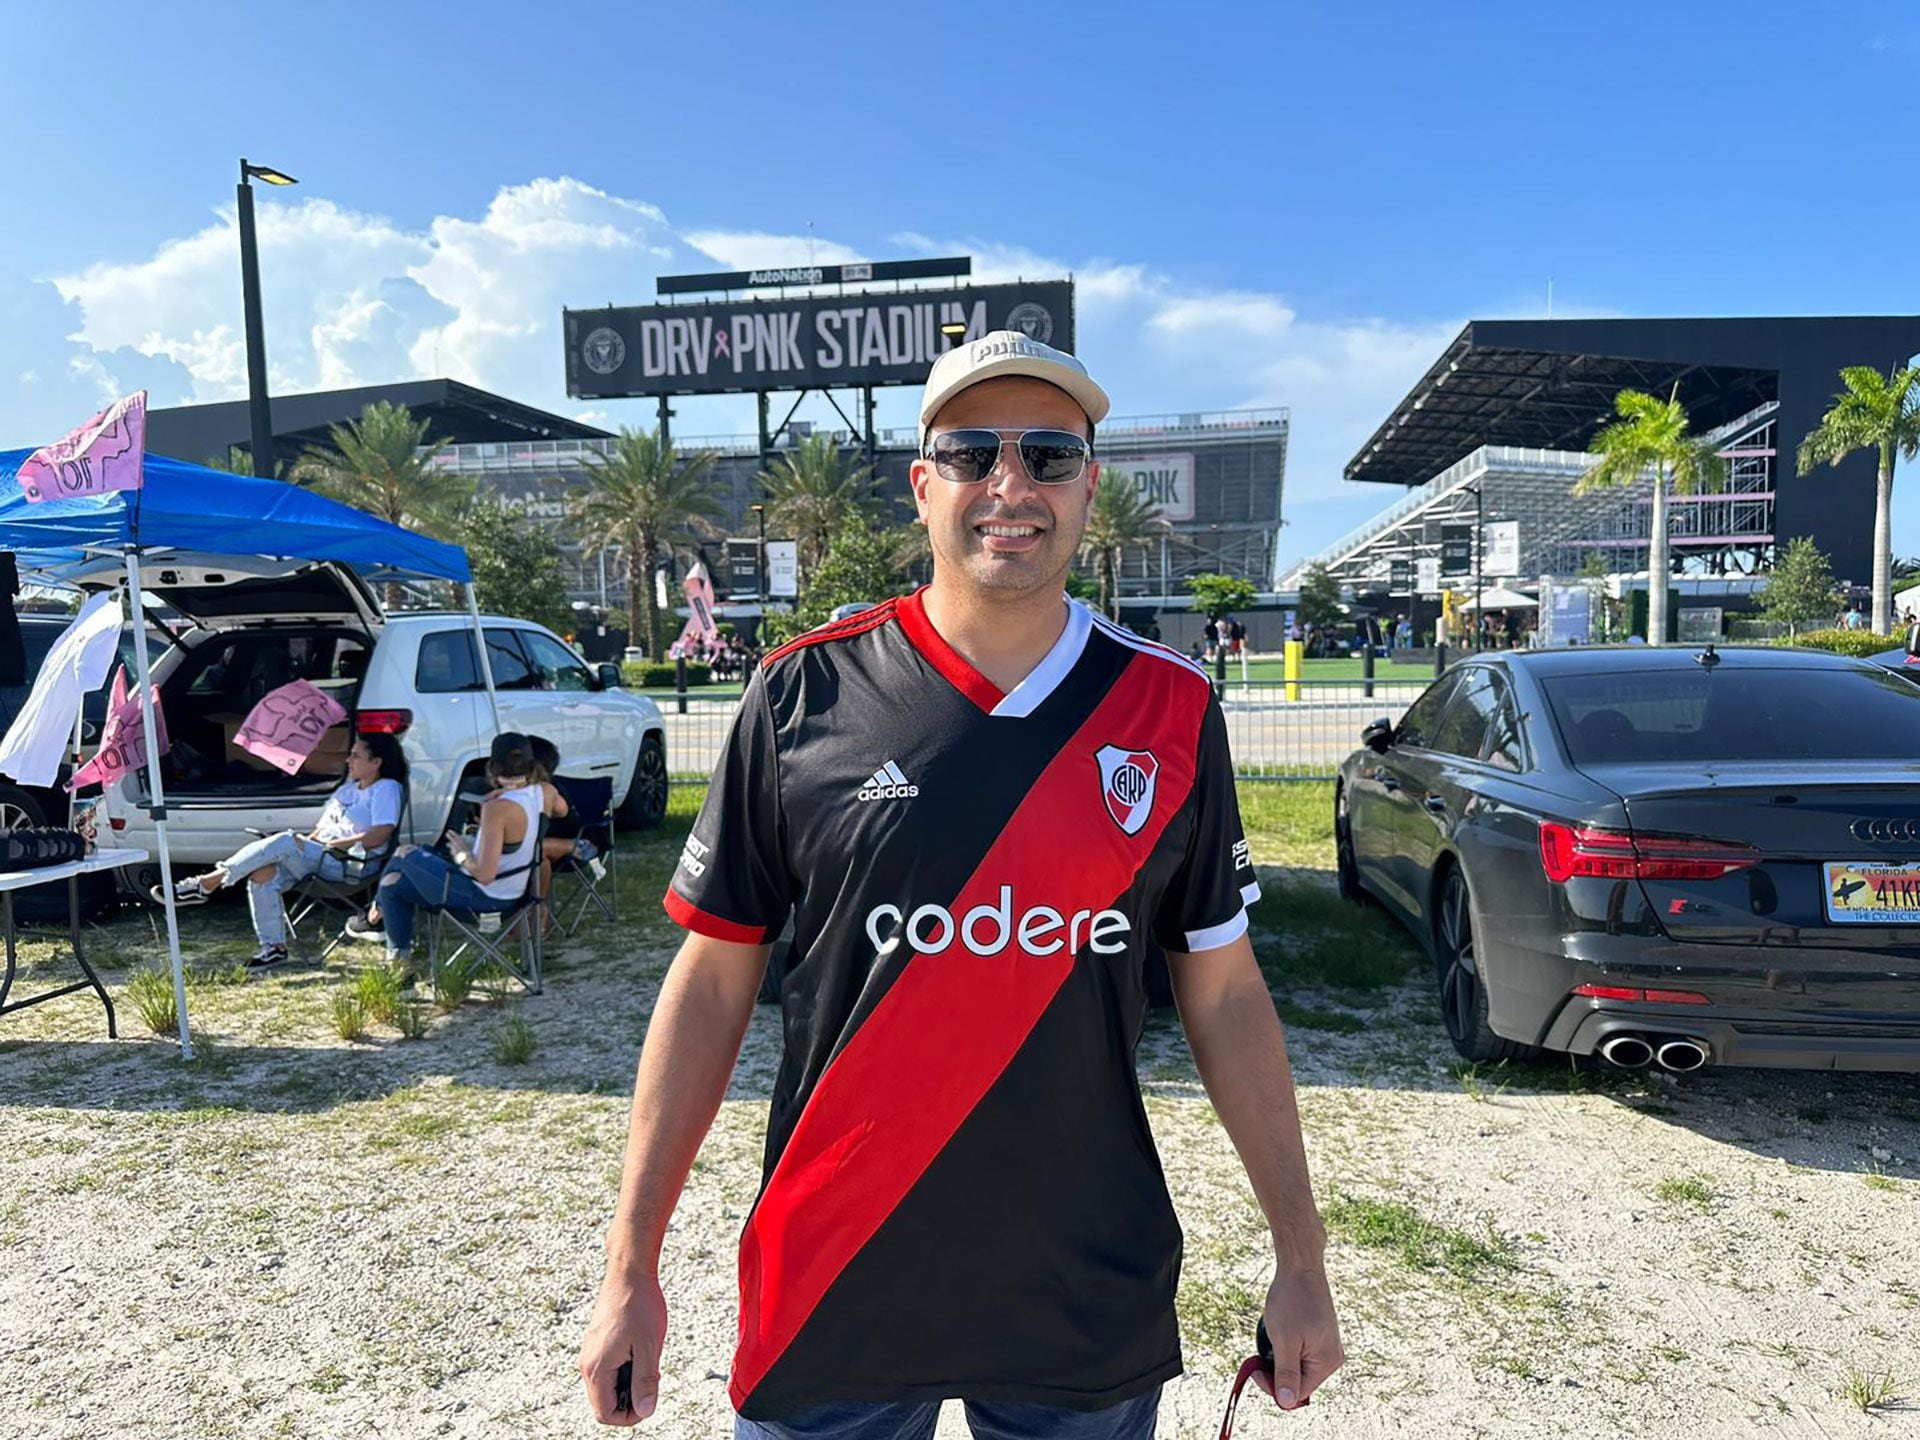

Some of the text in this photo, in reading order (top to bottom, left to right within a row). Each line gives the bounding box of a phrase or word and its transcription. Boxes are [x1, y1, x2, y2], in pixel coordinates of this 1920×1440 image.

[749, 269, 823, 284] AutoNation
[641, 317, 713, 377] DRV
[731, 312, 805, 373] PNK
[816, 301, 987, 369] STADIUM
[1134, 469, 1179, 504] PNK
[858, 785, 919, 801] adidas
[1862, 868, 1908, 876] FLORIDA
[866, 885, 1131, 956] codere
